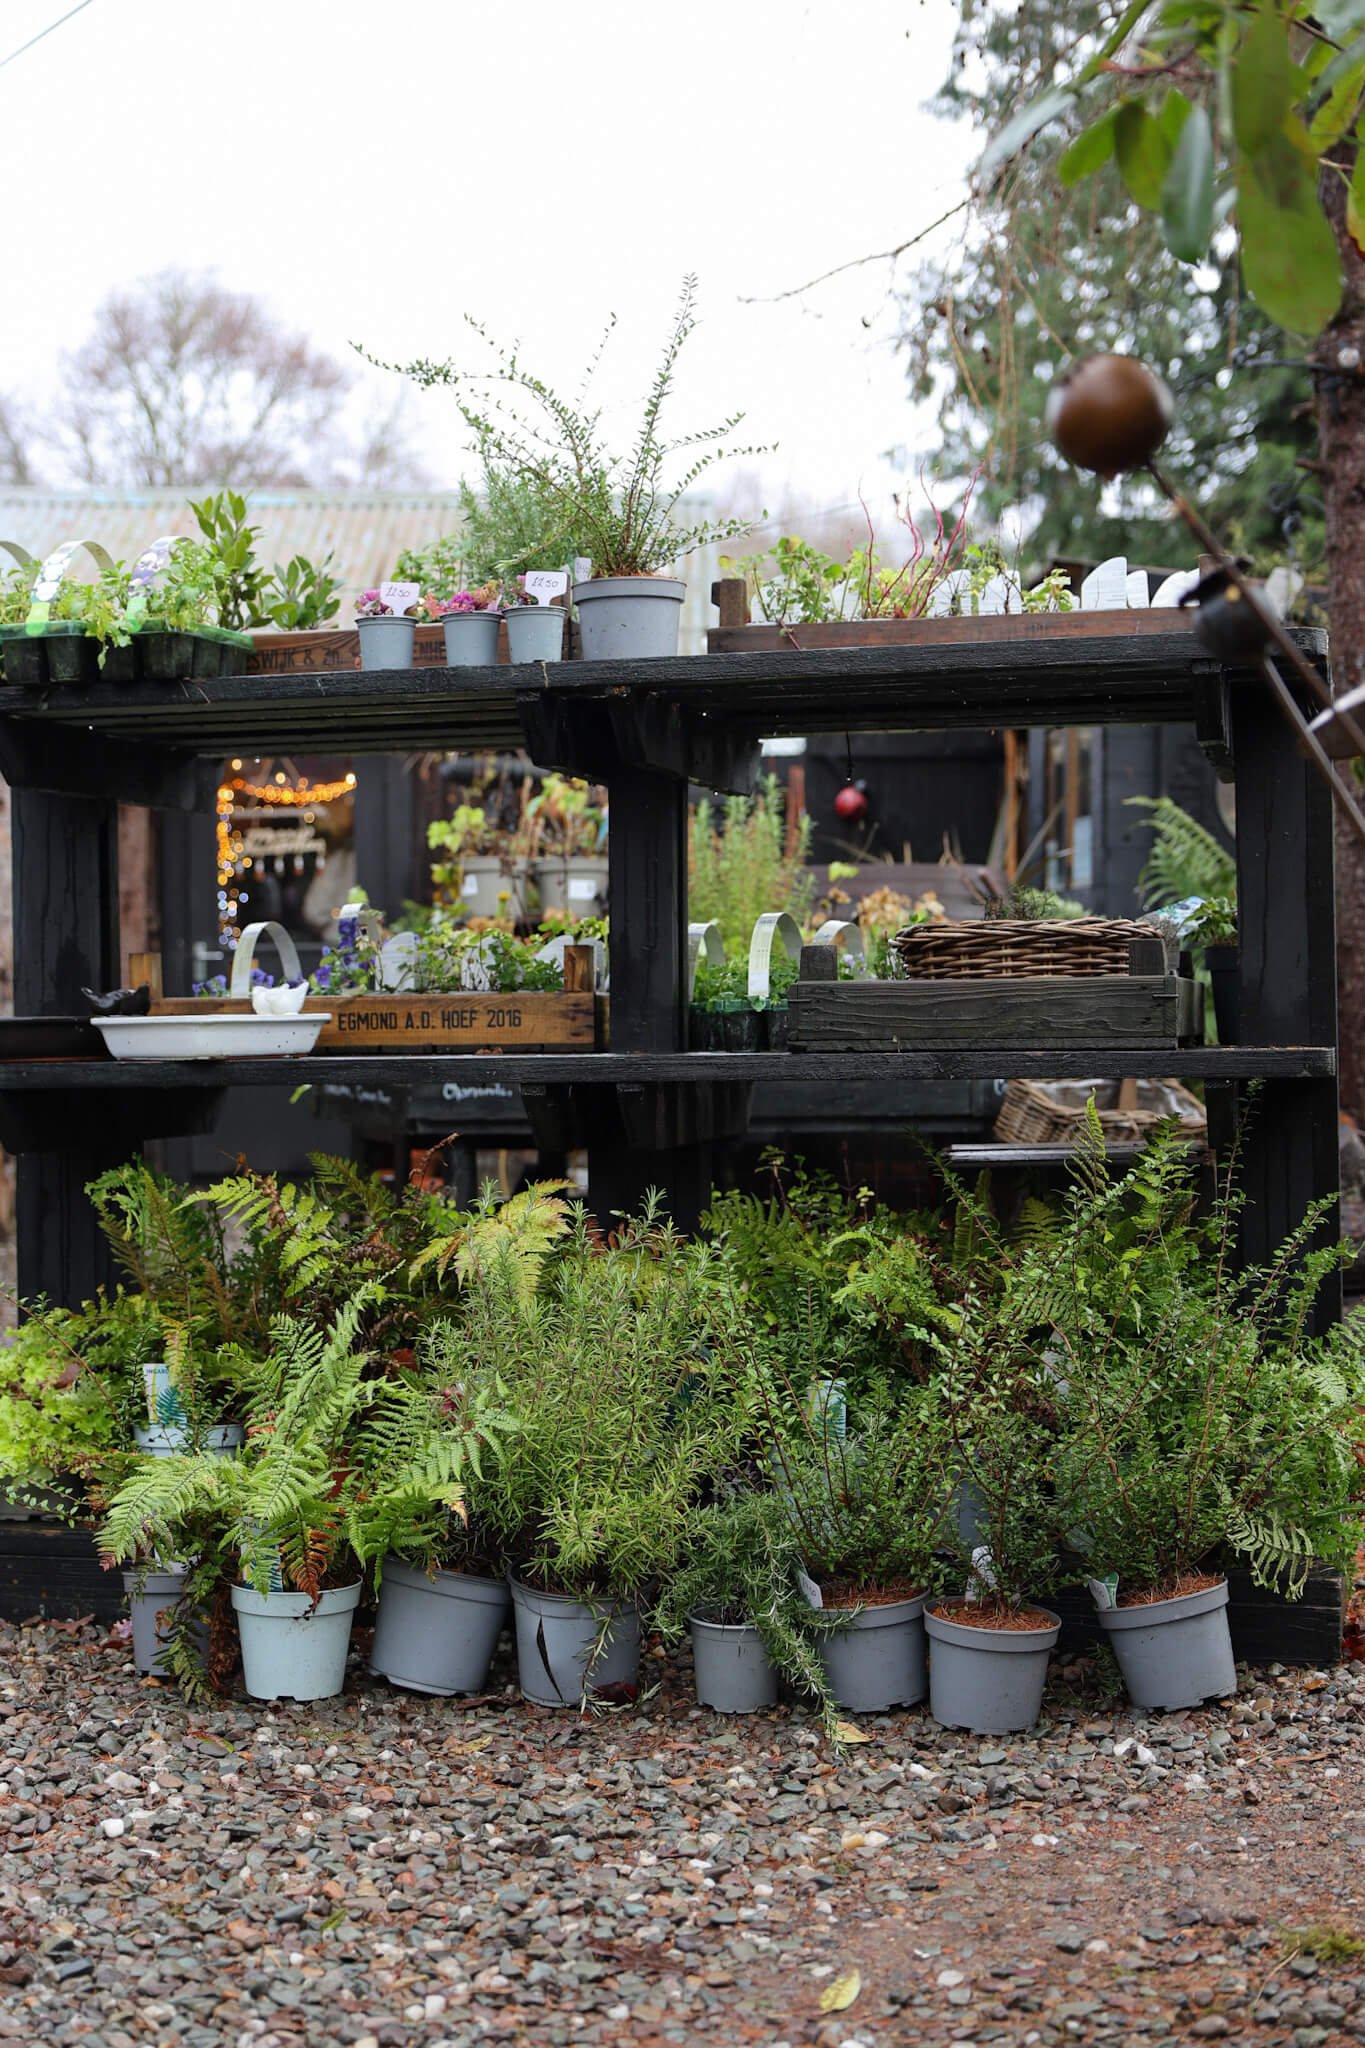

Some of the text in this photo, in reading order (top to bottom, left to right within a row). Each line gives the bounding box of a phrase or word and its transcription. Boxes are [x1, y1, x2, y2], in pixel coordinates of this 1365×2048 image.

[303, 648, 314, 666] &
[338, 1009, 522, 1031] EGMOND A.D. HOEF 2016
